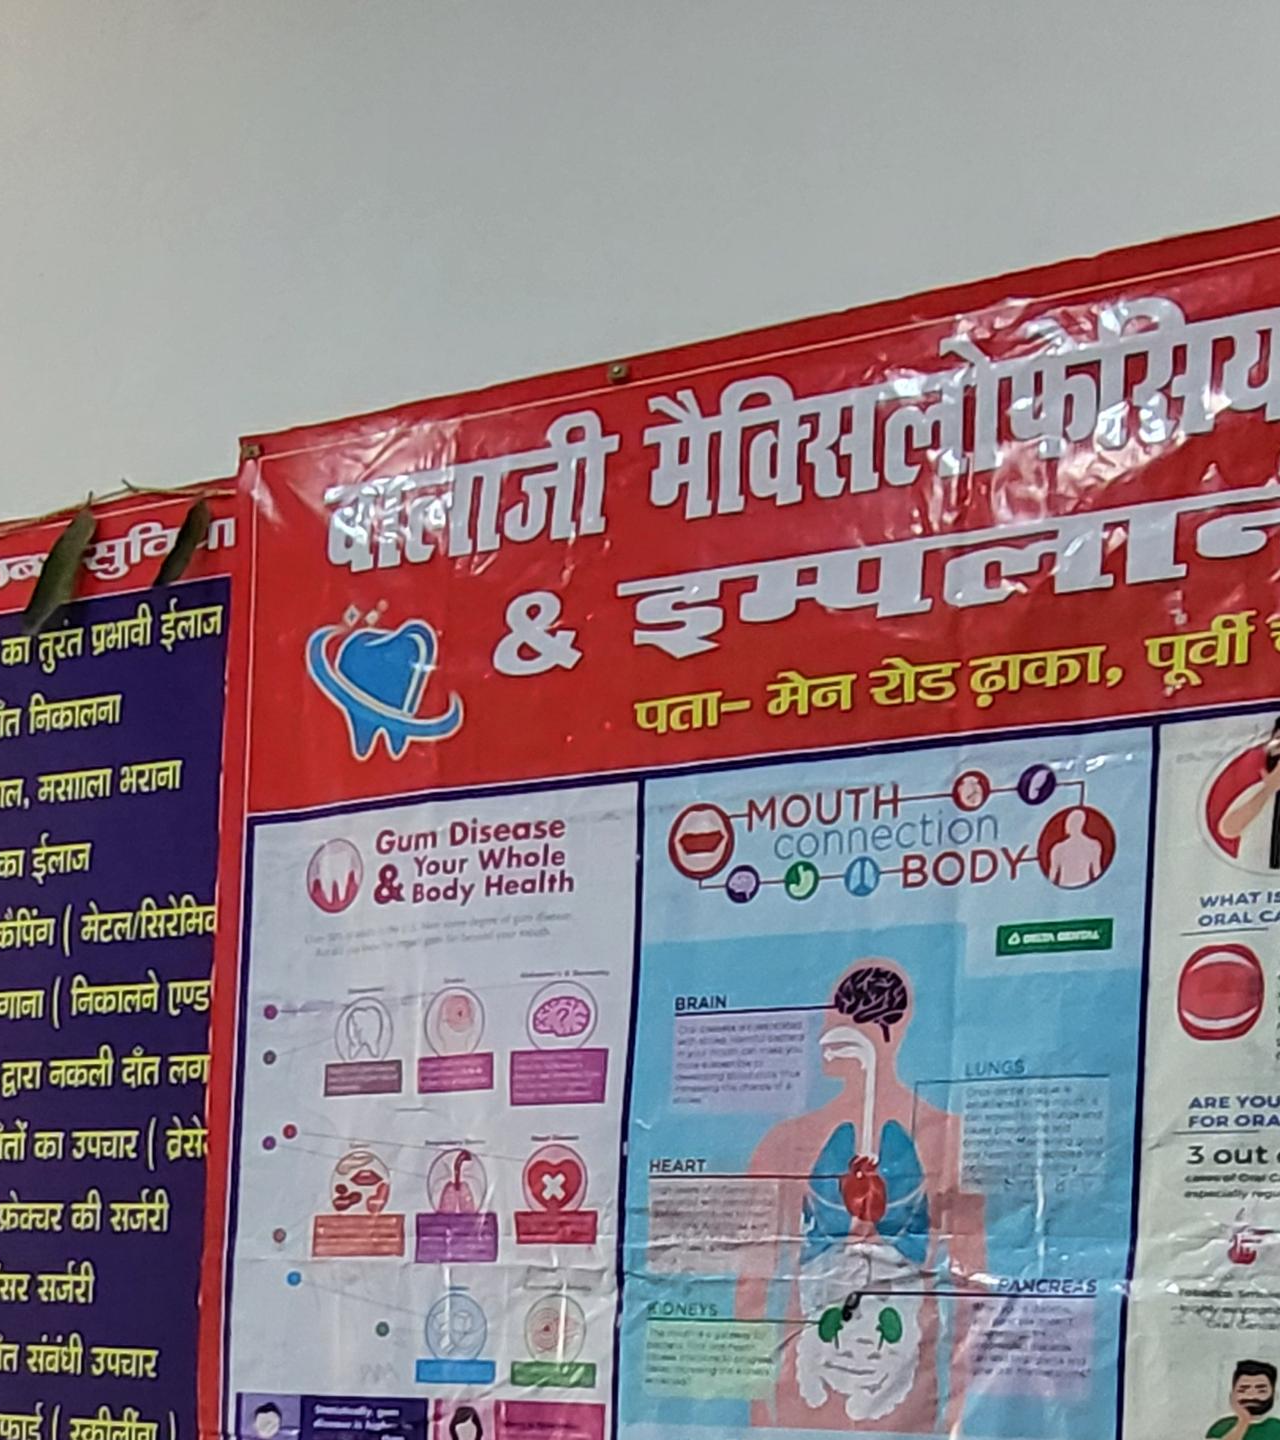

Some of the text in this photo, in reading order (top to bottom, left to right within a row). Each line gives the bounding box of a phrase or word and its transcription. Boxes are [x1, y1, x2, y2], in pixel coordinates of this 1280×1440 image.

[324, 410, 619, 572] बालाजी
[493, 591, 582, 675] &
[767, 669, 856, 717] मेन
[868, 656, 960, 705] रोड
[29, 693, 122, 733] निकालना
[747, 784, 900, 832] MOUTH
[376, 818, 566, 854] Gum Disease
[774, 811, 1000, 860] connection
[373, 844, 566, 904] & Your Whole
[901, 845, 1028, 888] BODY
[412, 869, 574, 906] Body Health
[675, 995, 727, 1011] BRAIN
[964, 1060, 1026, 1077] LUNGS
[1188, 1095, 1231, 1110] ARE
[1188, 1113, 1229, 1129] FOR
[649, 1158, 707, 1174] HEART
[1187, 1145, 1205, 1166] 3
[1213, 1146, 1268, 1166] out
